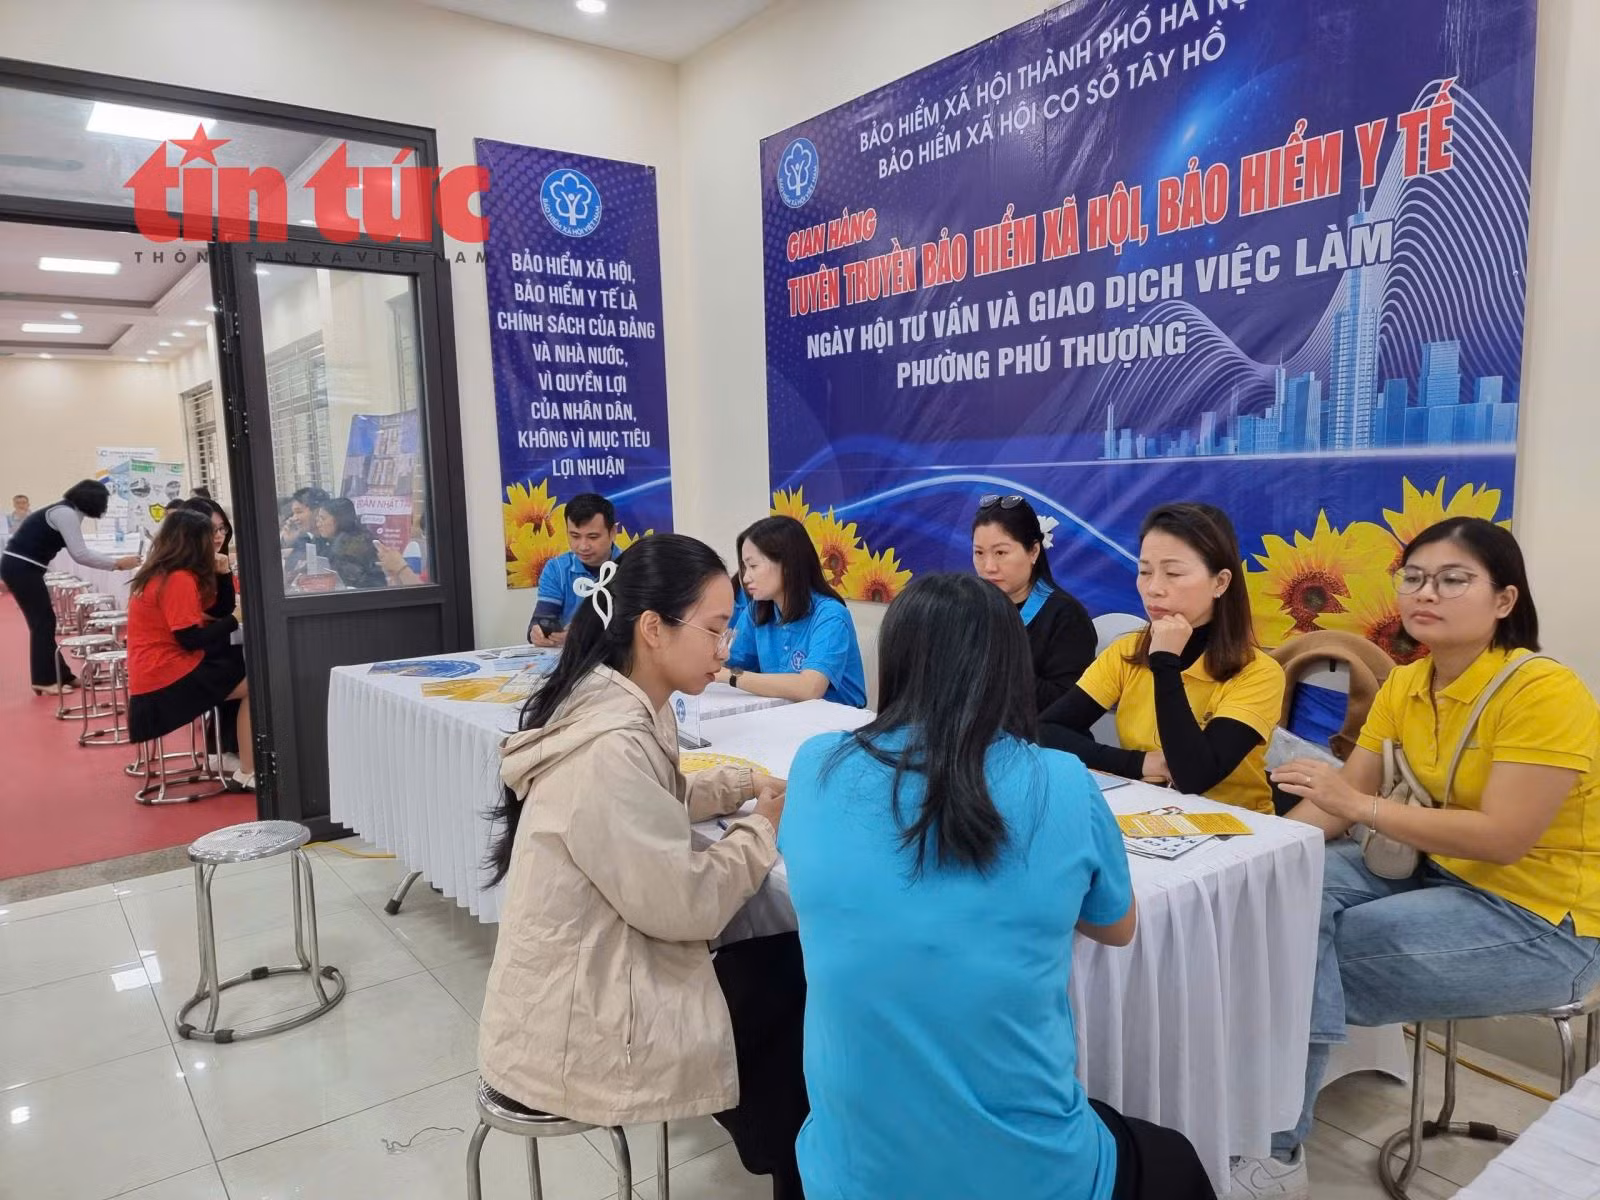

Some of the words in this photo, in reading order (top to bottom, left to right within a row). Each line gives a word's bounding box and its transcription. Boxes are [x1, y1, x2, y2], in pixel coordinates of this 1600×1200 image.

[860, 121, 894, 153] BẢO
[899, 97, 940, 138] HIỂM
[944, 90, 971, 116] XÃ
[976, 72, 1012, 106] HỘI
[1017, 39, 1091, 90] THÀNH
[1099, 4, 1151, 59] PHỐ
[879, 144, 914, 179] BẢO
[918, 125, 961, 166] HIỂM
[965, 113, 994, 150] XÃ
[1000, 101, 1036, 140] HỘI
[1043, 88, 1081, 120] CƠ
[1086, 65, 1120, 105] SỞ
[1126, 51, 1175, 90] TÂY
[1183, 19, 1226, 71] HỒ
[787, 264, 840, 317] TUYÊN
[843, 237, 917, 305] TRUYỀN
[921, 228, 968, 289] BẢO
[973, 203, 1037, 277] HIỂM
[1042, 194, 1080, 262] XÃ
[1087, 181, 1149, 256] HỘI,
[1157, 157, 1229, 236] BẢO
[1239, 118, 1344, 217] HIỂM
[1354, 118, 1388, 189] Y
[1397, 75, 1459, 180] TẾ
[786, 223, 826, 262] GIAN
[511, 248, 543, 273] BẢO
[546, 251, 582, 277] HIỂM
[586, 258, 606, 280] XÃ
[609, 260, 636, 285] HỘI,
[514, 279, 545, 303] BẢO
[548, 281, 584, 306] HIỂM
[587, 289, 598, 307] Y
[600, 286, 619, 309] TẾ
[620, 289, 638, 311] LÀ
[807, 325, 855, 359] NGÀY
[861, 316, 893, 353] HỘI
[900, 311, 927, 344] TƯ
[932, 297, 979, 338] VẤN
[986, 291, 1020, 329] VÀ
[1029, 281, 1095, 323] GIAO
[1105, 263, 1183, 313] DỊCH
[1195, 242, 1280, 295] VIỆC
[1295, 221, 1394, 277] LÀM
[497, 310, 543, 332] CHÍNH
[547, 312, 585, 335] SÁCH
[589, 313, 616, 337] CỦA
[619, 316, 656, 339] ĐẢNG
[532, 340, 551, 362] VÀ
[555, 342, 585, 364] NHÀ
[588, 344, 628, 368] NƯỚC,
[897, 348, 990, 389] PHƯỜNG
[998, 334, 1051, 377] PHÚ
[1060, 320, 1188, 368] THƯỢNG
[538, 369, 552, 391] VÌ
[555, 369, 603, 393] QUYỀN
[606, 375, 627, 397] LỢI
[531, 396, 560, 419] CỦA
[563, 399, 602, 420] NHÂN
[606, 400, 637, 423] DÂN,
[518, 427, 568, 448] KHÔNG
[571, 427, 585, 448] VÌ
[588, 431, 619, 451] MỤC
[621, 427, 651, 448] TIÊU
[552, 459, 574, 479] LỢI
[577, 455, 625, 478] NHUẬN
